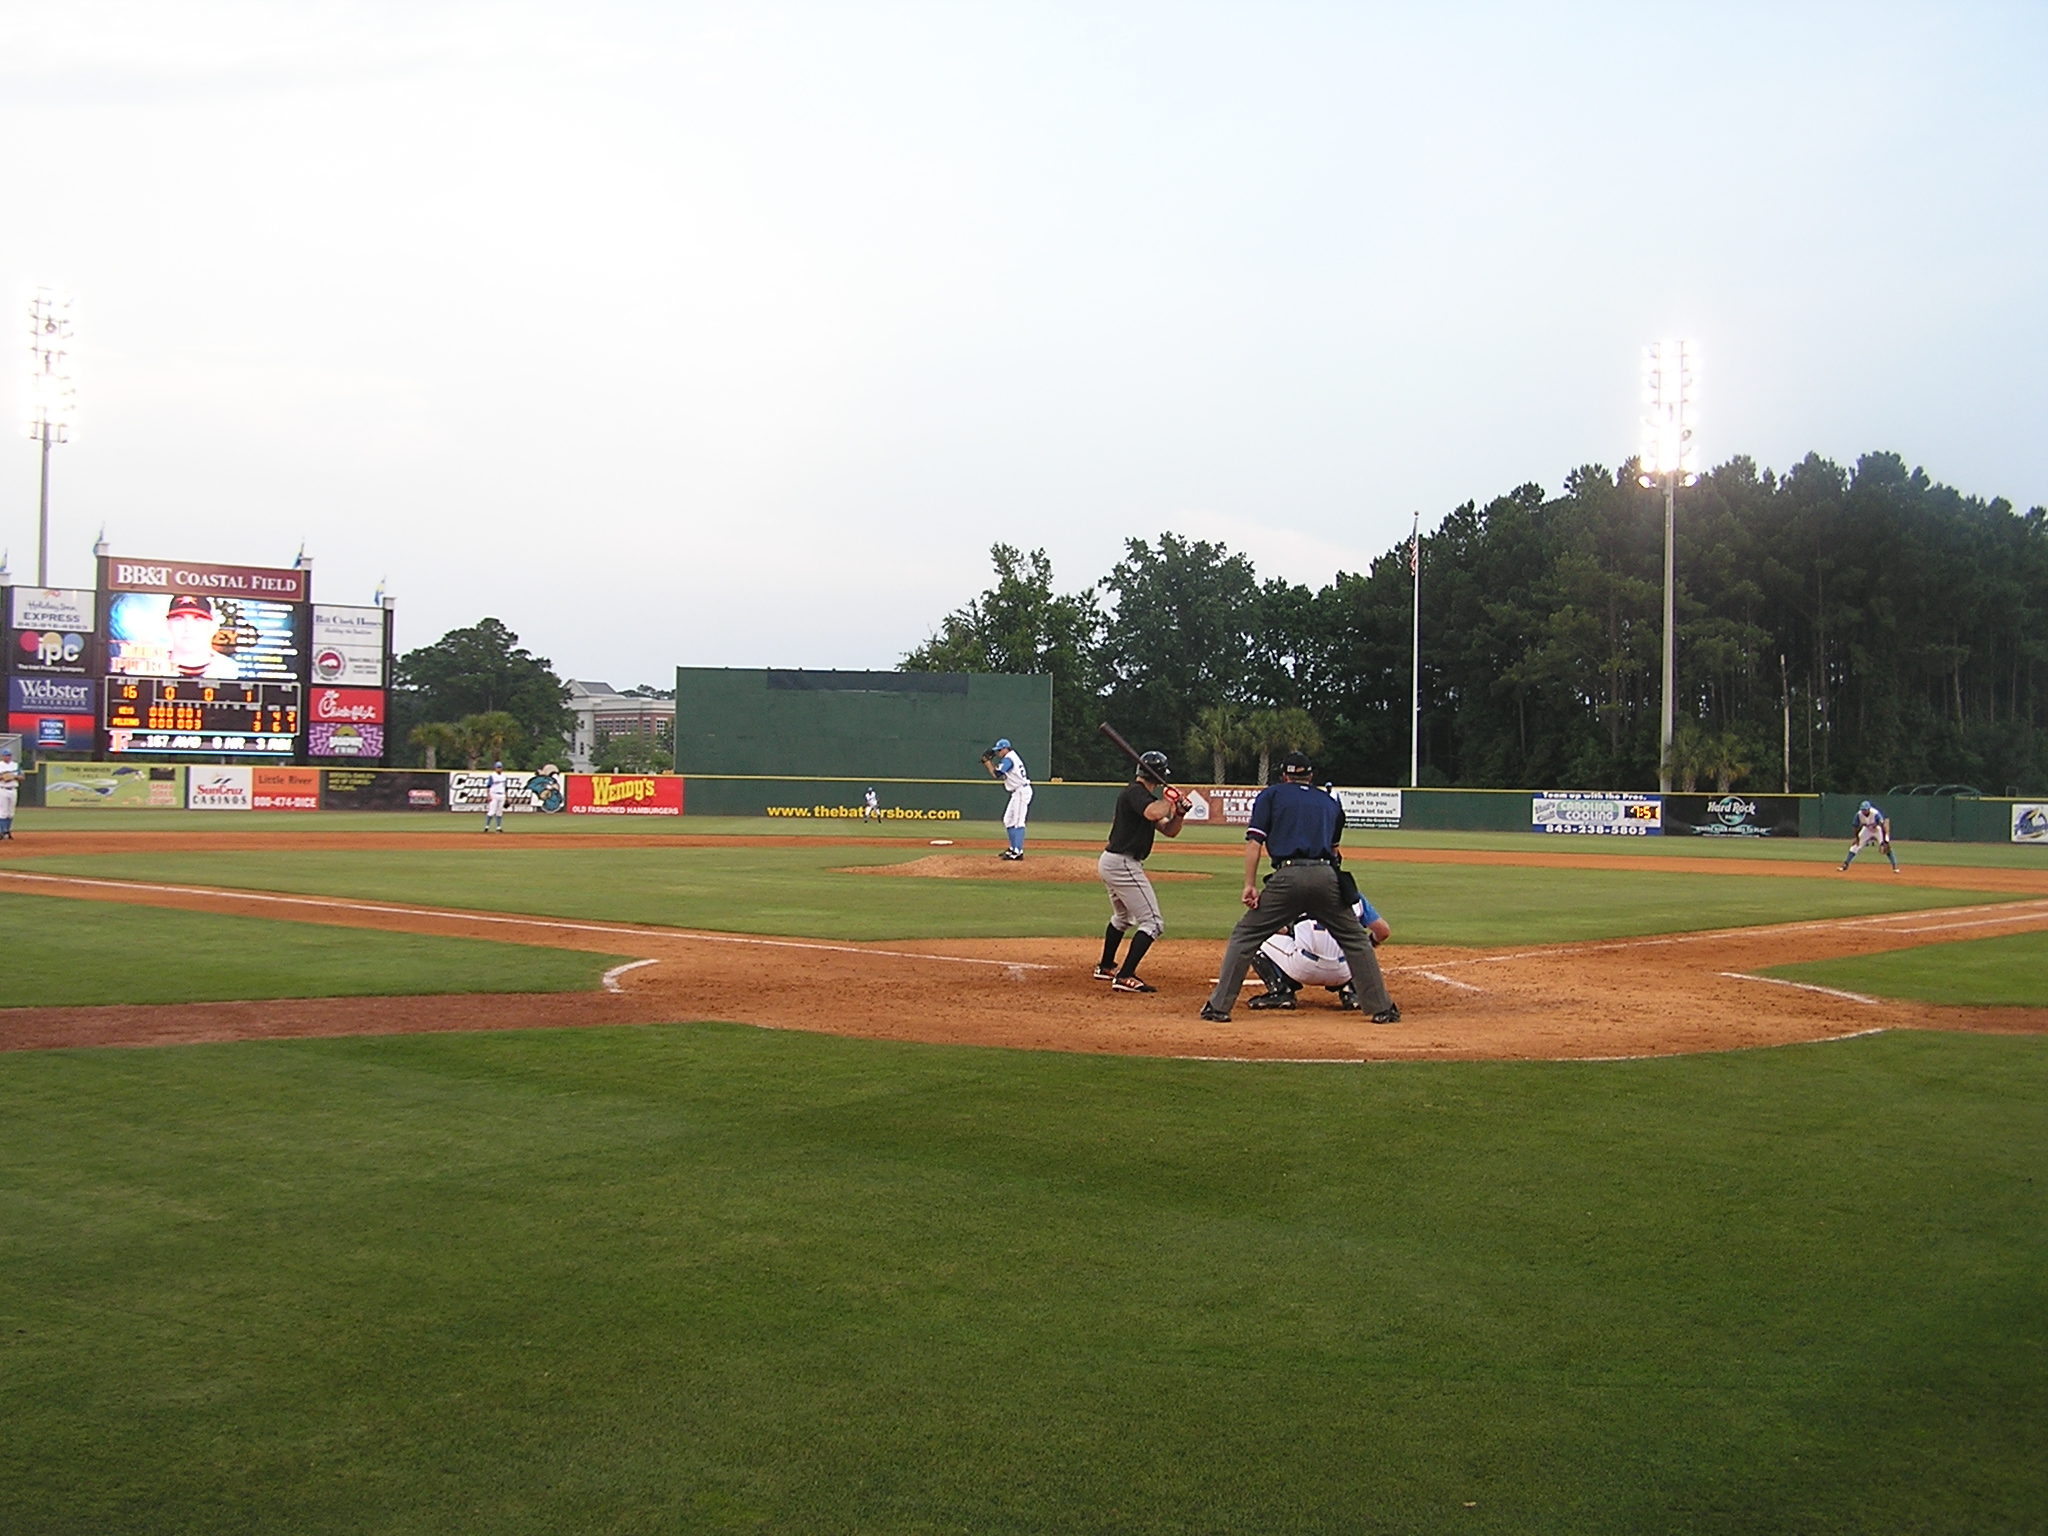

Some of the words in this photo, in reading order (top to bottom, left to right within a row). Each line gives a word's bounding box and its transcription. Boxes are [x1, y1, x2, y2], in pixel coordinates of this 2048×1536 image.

[117, 565, 171, 586] BB&T
[175, 571, 248, 589] COASTAL
[252, 576, 297, 592] FIELD
[24, 612, 80, 622] EXPRESS
[38, 637, 79, 666] ipc
[19, 679, 89, 699] Webster
[123, 685, 138, 699] 16
[165, 686, 176, 701] 0
[204, 687, 214, 702] 0
[246, 689, 253, 702] 1
[253, 721, 262, 733] 3
[272, 722, 281, 733] 6
[255, 737, 266, 751] 3
[258, 775, 284, 784] Little
[289, 775, 313, 785] River
[197, 785, 243, 795] SunCruz
[592, 777, 655, 805] Wendy's
[1210, 790, 1231, 798] SAFE
[1232, 790, 1244, 798] AT
[193, 796, 247, 804] CASINOS
[588, 806, 626, 814] FASHIONED
[627, 807, 679, 815] HAMBURGERS
[1707, 801, 1732, 813] Hard
[1732, 802, 1756, 815] Rock
[1546, 825, 1647, 836] 843-238-5805
